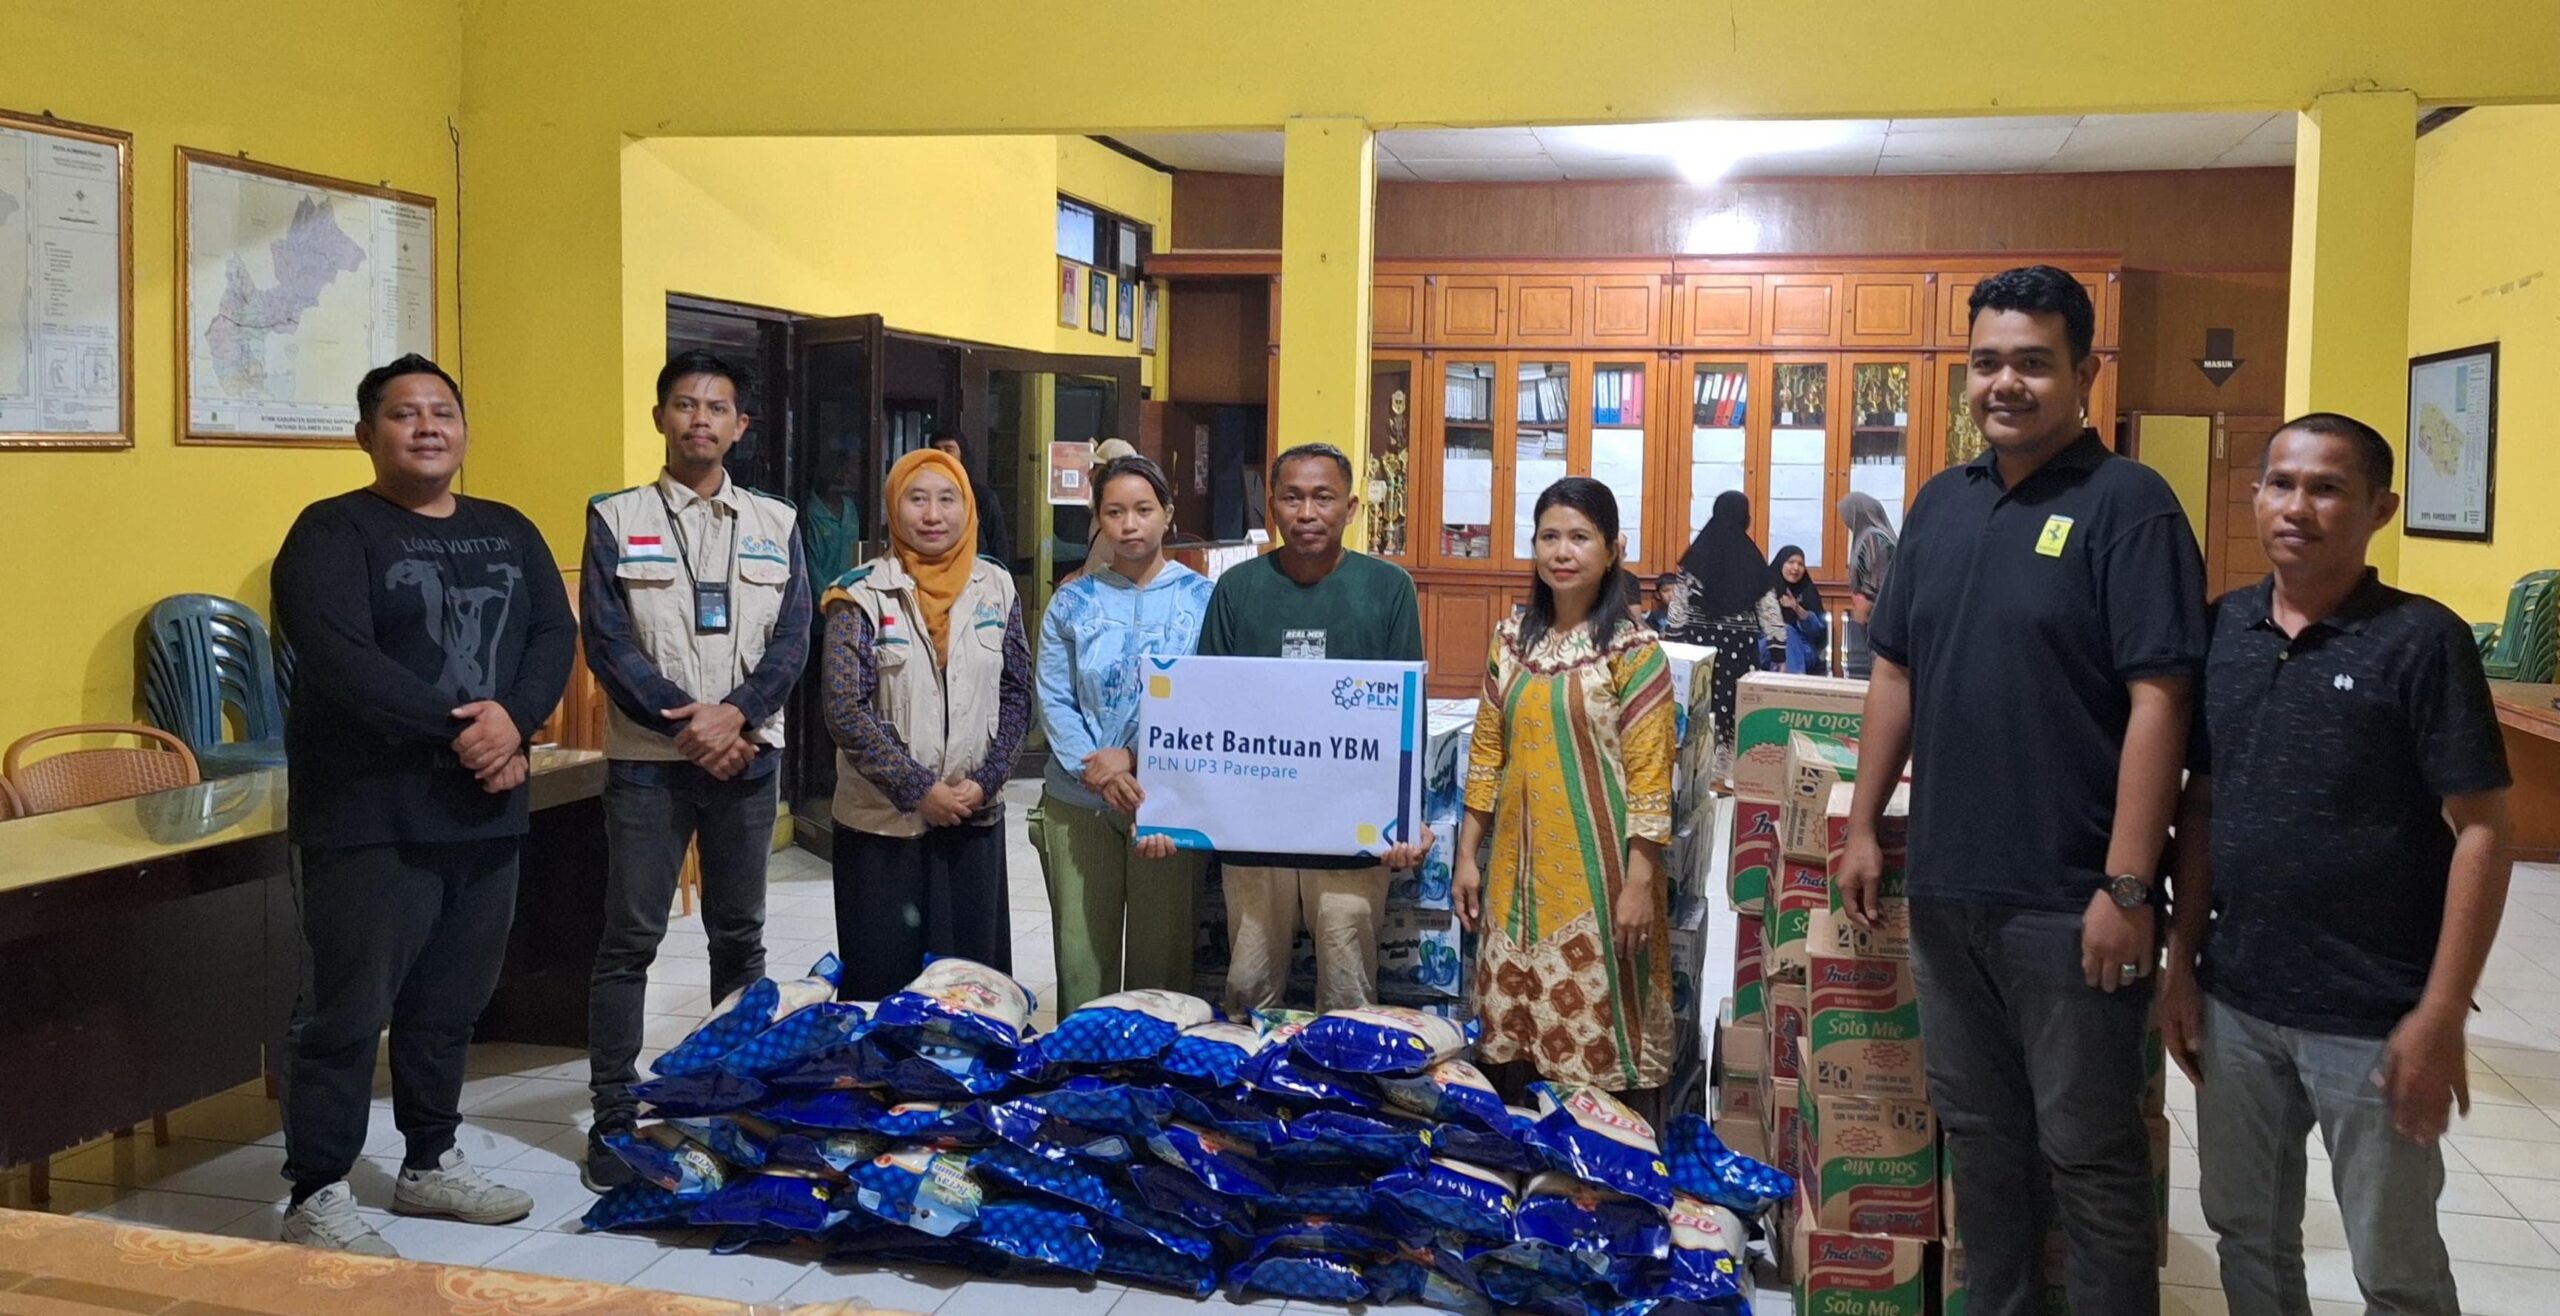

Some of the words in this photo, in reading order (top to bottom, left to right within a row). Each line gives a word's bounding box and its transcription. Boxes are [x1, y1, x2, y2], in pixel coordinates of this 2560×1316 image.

[2203, 360, 2233, 369] MASUK
[1366, 681, 1399, 695] YBM
[1367, 694, 1398, 707] PLN
[1778, 711, 1813, 729] Mie
[1818, 714, 1863, 733] Soto
[1149, 726, 1215, 752] Paket
[1222, 730, 1322, 759] Bantuan
[1330, 737, 1380, 762] YBM
[1148, 756, 1179, 772] PLN
[1185, 758, 1217, 774] UP3
[1223, 760, 1298, 781] Parepare
[1795, 868, 1828, 888] Indo
[1828, 1018, 1867, 1036] Soto
[1871, 1020, 1904, 1038] Mie
[1842, 1158, 1876, 1177] Mie
[1879, 1161, 1919, 1178] Soto
[1823, 1296, 1863, 1315] Soto
[1867, 1300, 1901, 1316] Mie
